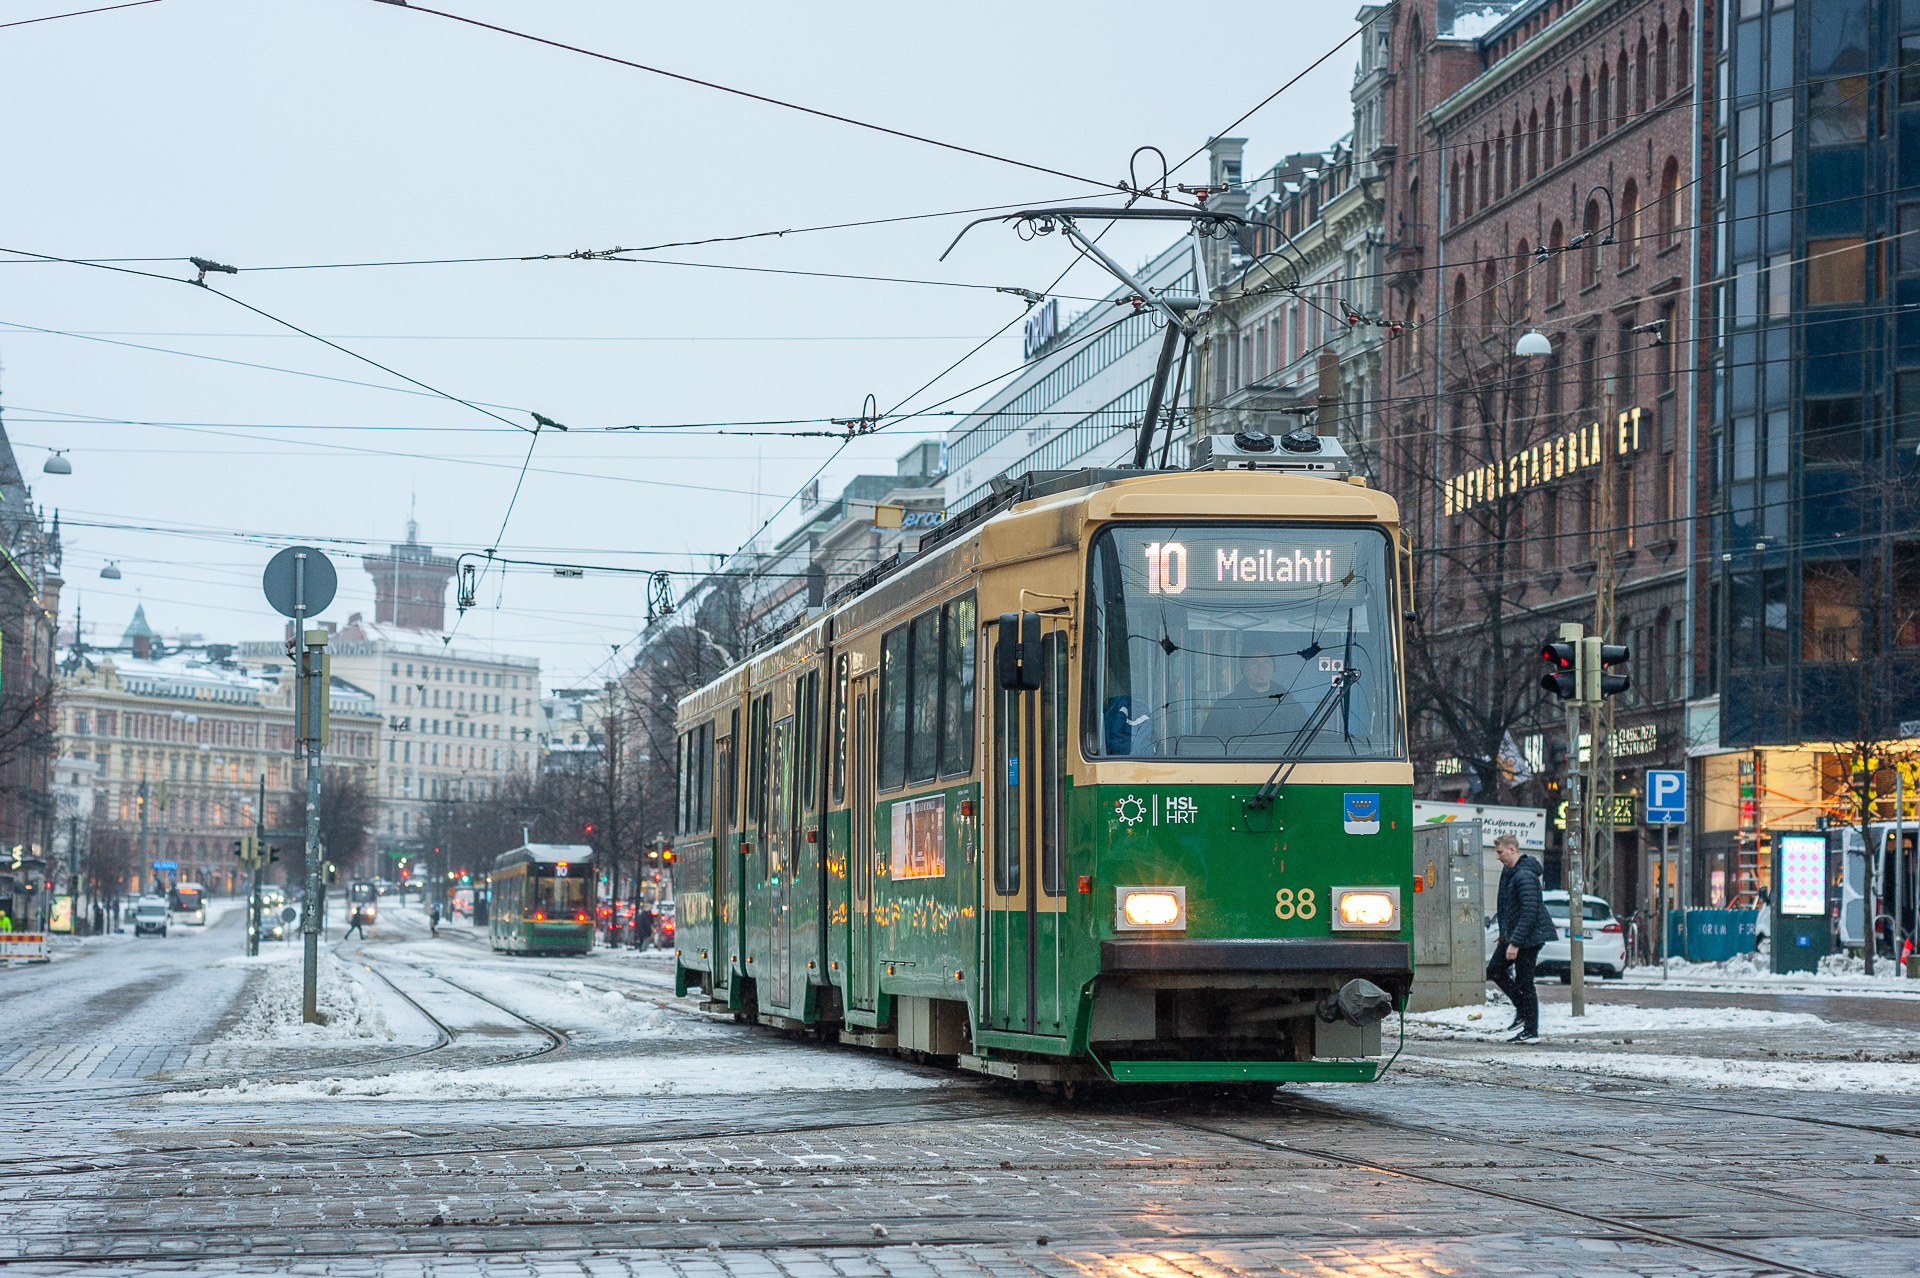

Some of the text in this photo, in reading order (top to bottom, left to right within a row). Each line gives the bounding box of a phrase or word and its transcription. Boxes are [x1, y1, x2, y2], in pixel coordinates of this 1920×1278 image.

[1444, 406, 1641, 517] HUFVUDSTADSBLAET
[1144, 542, 1332, 595] 10 Meilahti
[1655, 773, 1680, 806] P
[1166, 796, 1198, 810] HSL
[1166, 811, 1198, 824] HRT
[1483, 818, 1537, 829] Kuljetus.fi
[1786, 838, 1823, 853] Wow!
[555, 865, 568, 877] 10
[1275, 888, 1317, 920] 88
